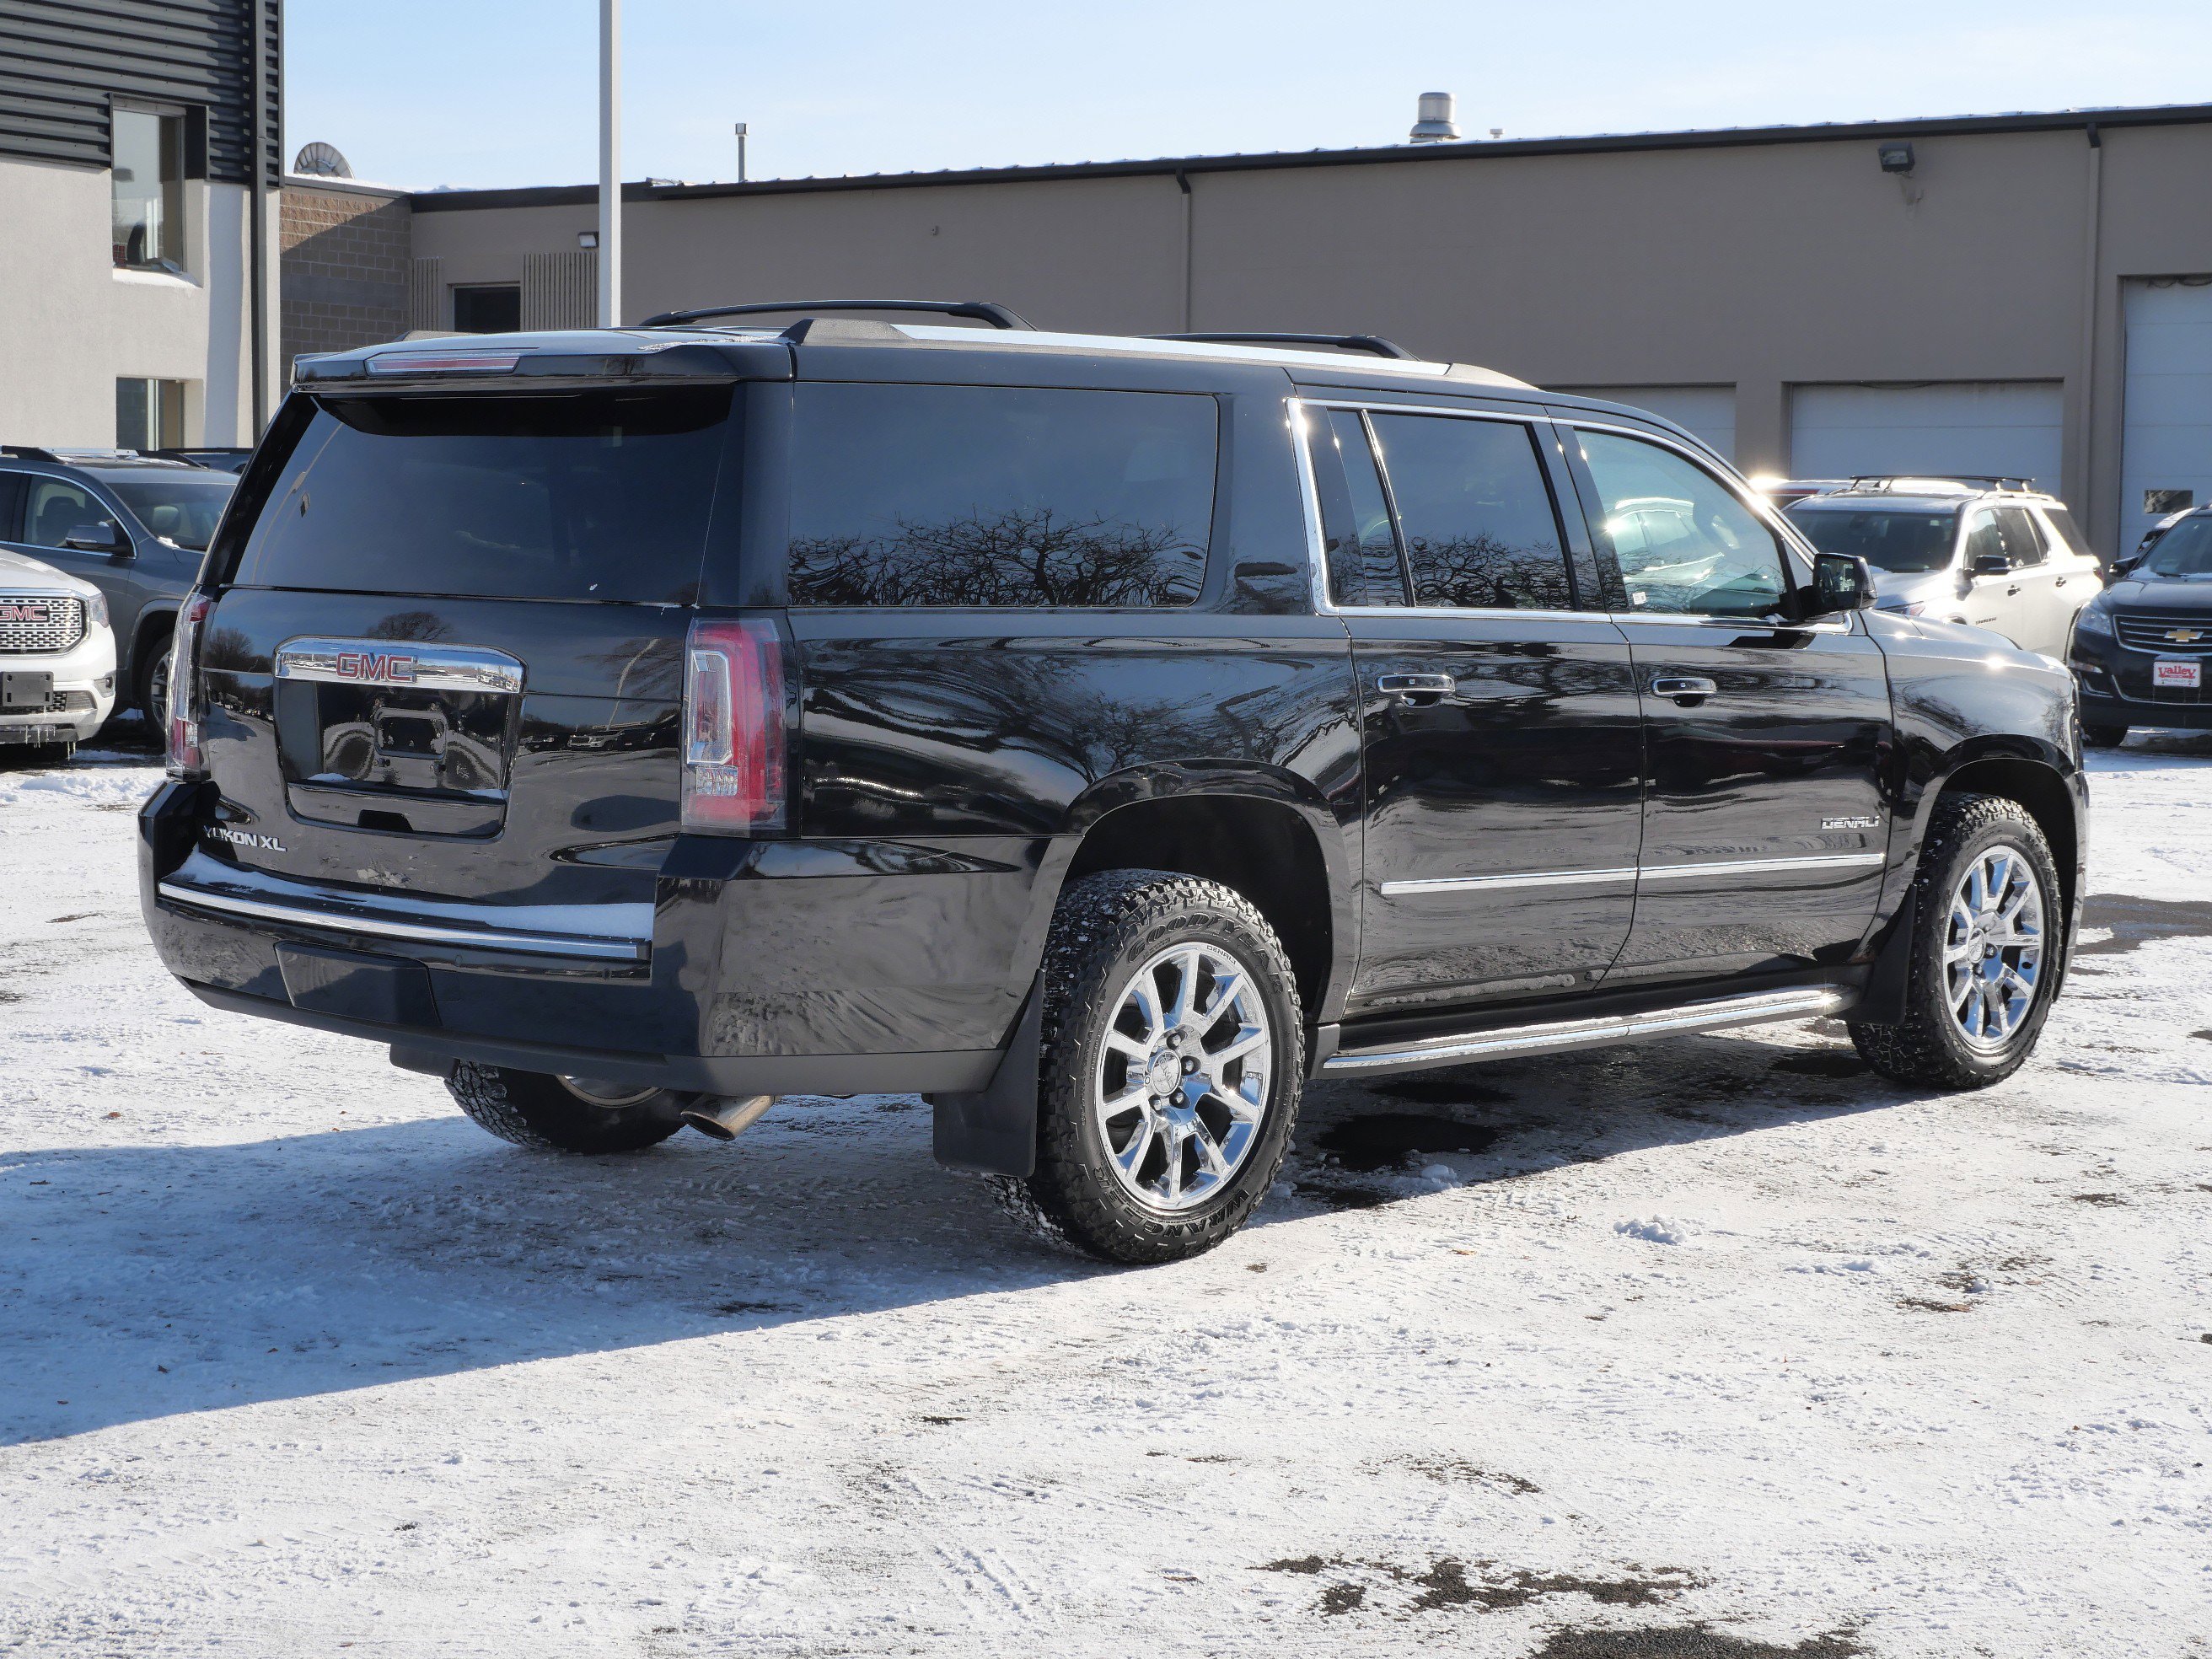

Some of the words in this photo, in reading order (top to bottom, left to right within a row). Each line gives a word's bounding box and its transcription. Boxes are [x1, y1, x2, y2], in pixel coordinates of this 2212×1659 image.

[0, 605, 48, 621] GMC
[336, 652, 418, 684] GMC
[1821, 815, 1881, 830] DENALI
[203, 825, 258, 847] YUKON
[260, 835, 287, 852] XL
[1127, 912, 1284, 994] GOODYEAR
[1206, 945, 1237, 965] DENALI
[1093, 1167, 1251, 1238] WRANGLER
